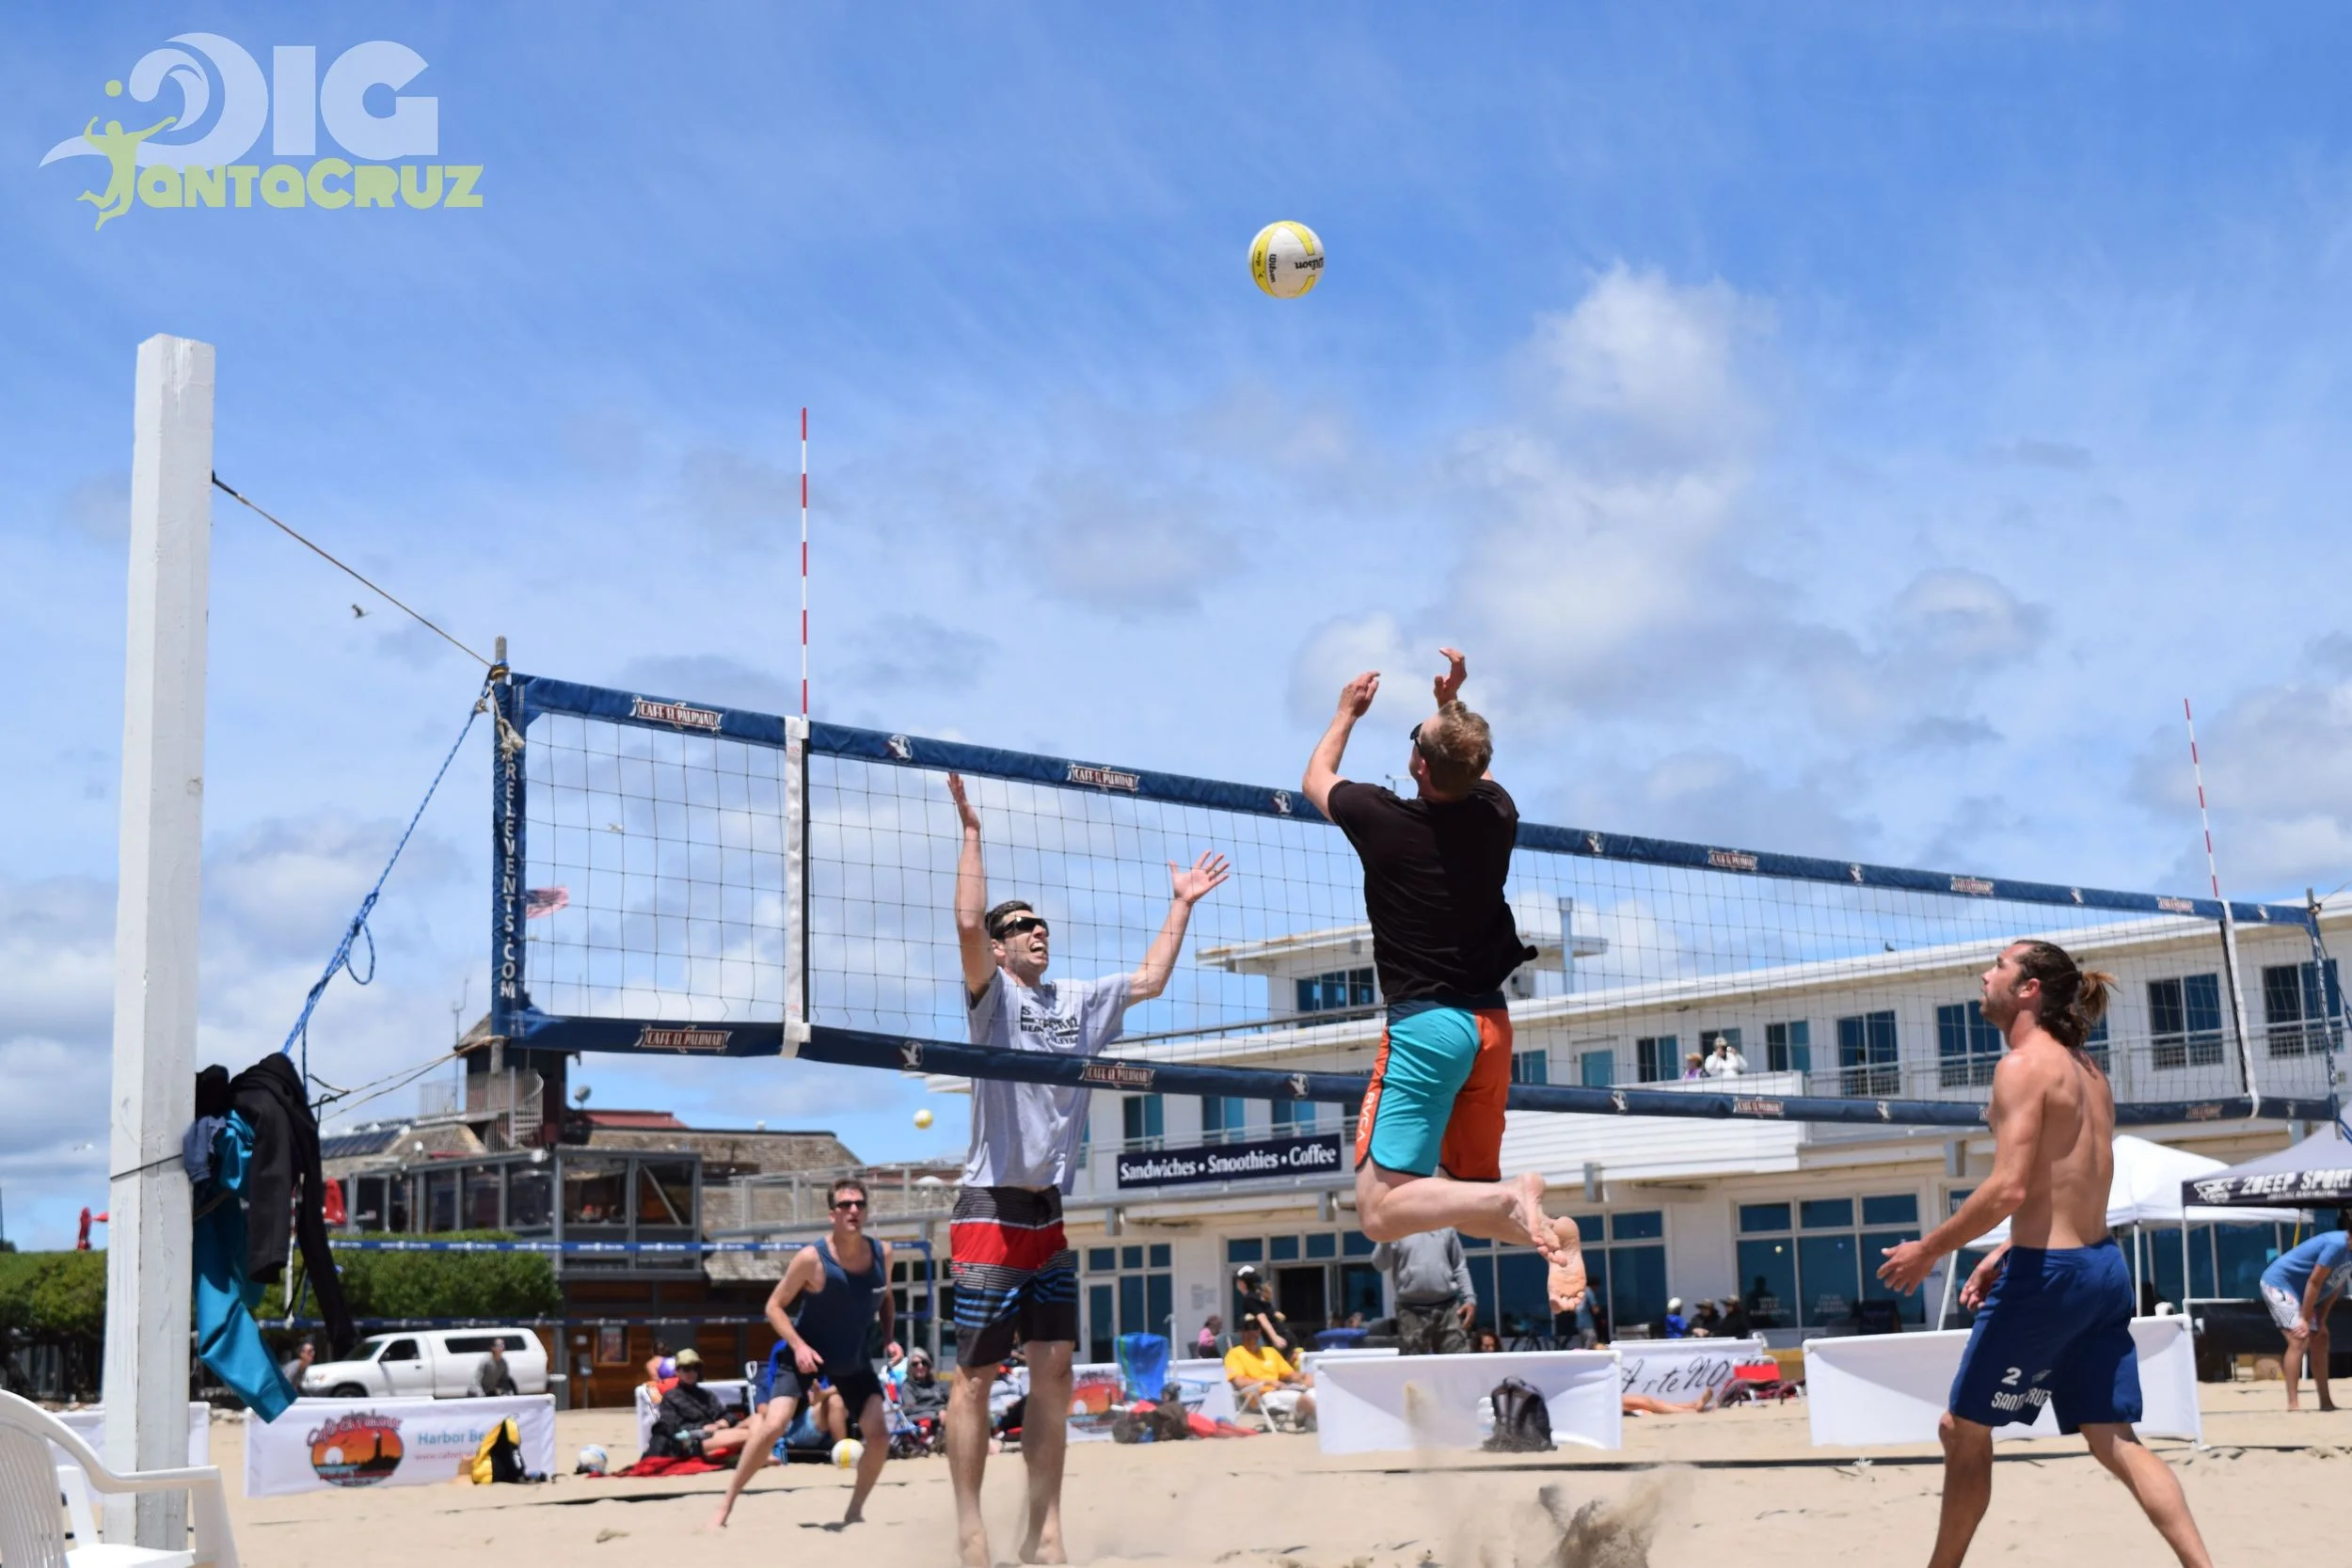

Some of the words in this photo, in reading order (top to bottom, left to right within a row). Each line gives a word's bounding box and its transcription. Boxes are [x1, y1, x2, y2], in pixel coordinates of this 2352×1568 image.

[1268, 253, 1278, 283] Wilson
[1357, 1092, 1375, 1142] RVCA
[1120, 1152, 1196, 1181] Sandwiches
[1207, 1149, 1279, 1174] Smoothies
[1289, 1143, 1337, 1166] Coffee
[2001, 1367, 2022, 1386] 2
[2025, 1386, 2053, 1407] RUZ
[418, 1429, 467, 1445] Harbor
[469, 1429, 485, 1443] Be
